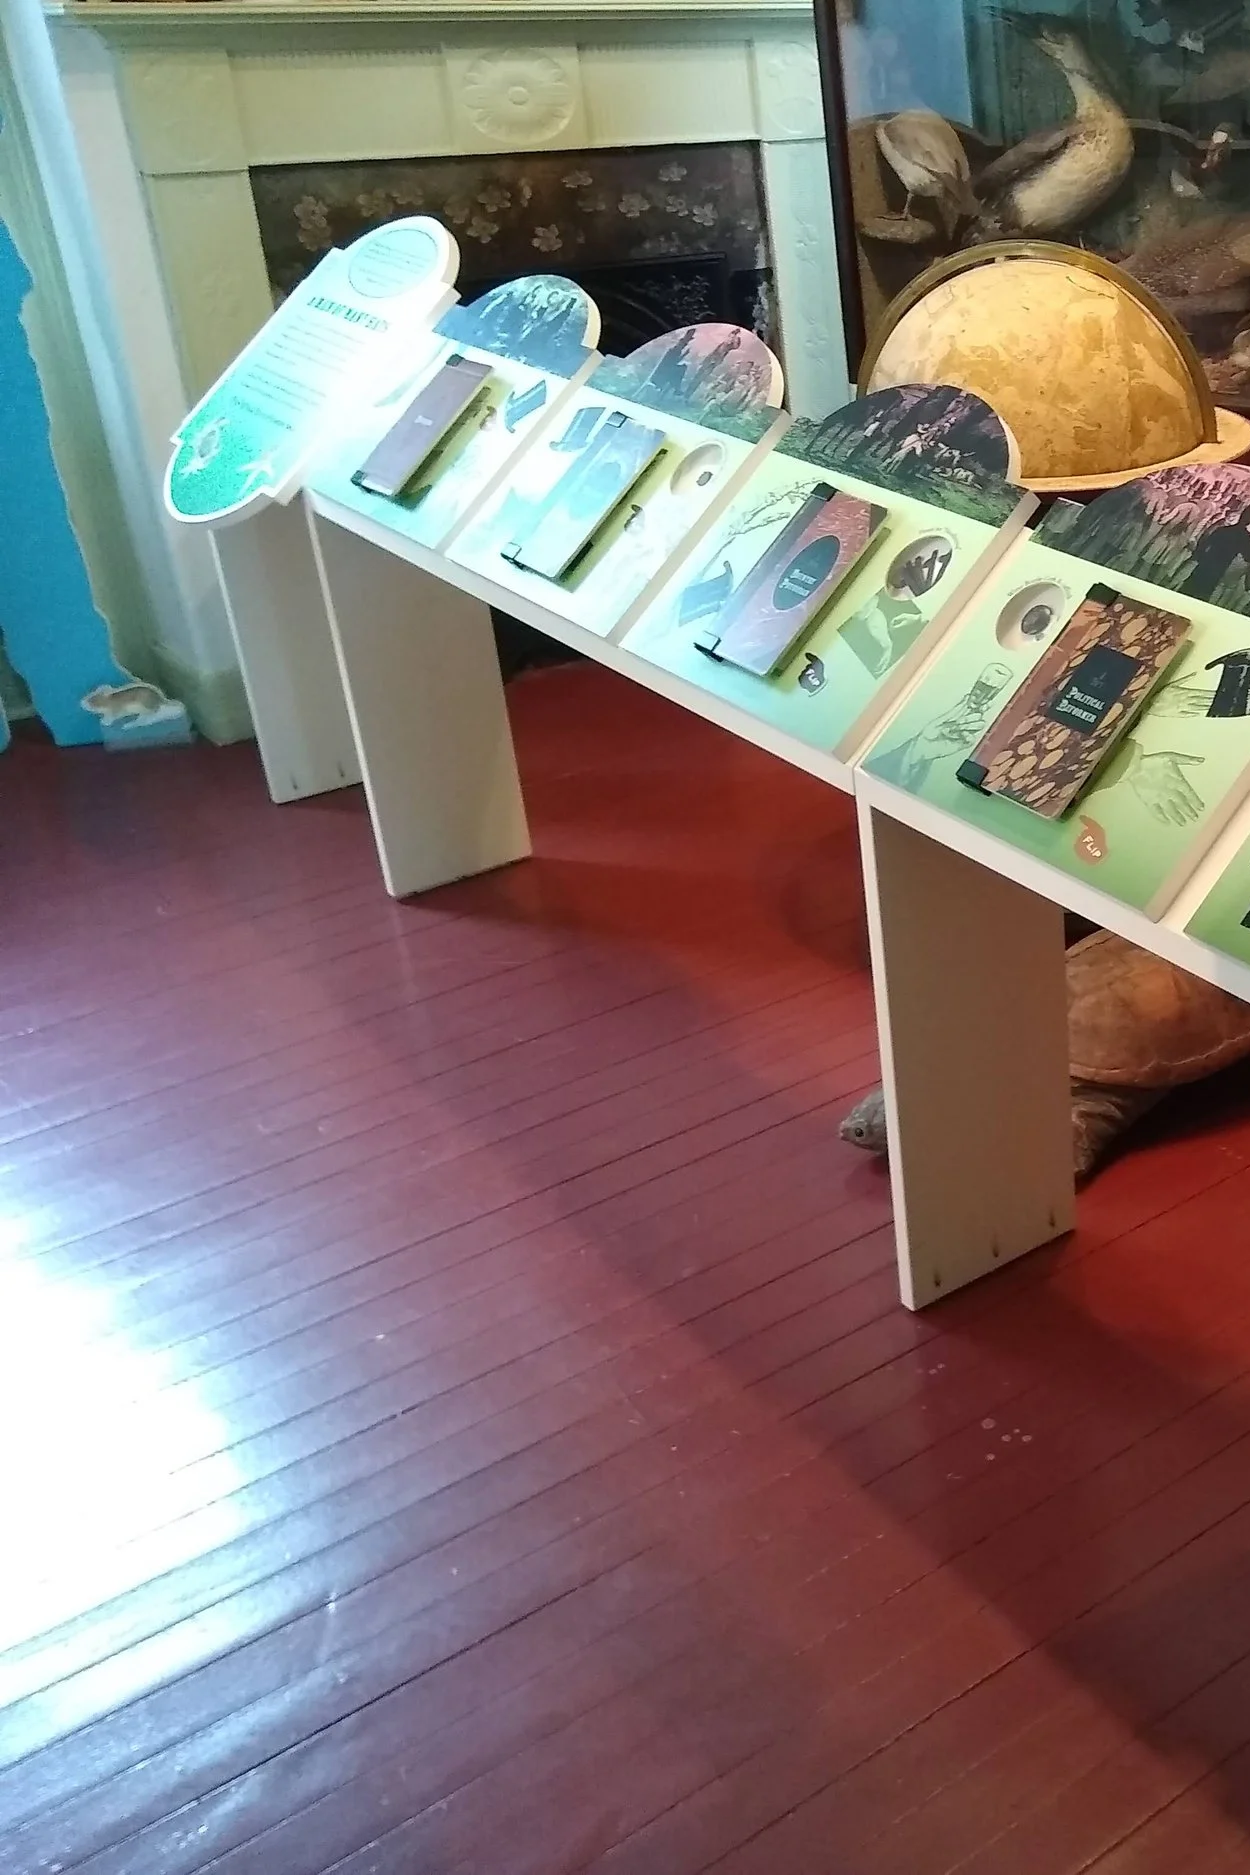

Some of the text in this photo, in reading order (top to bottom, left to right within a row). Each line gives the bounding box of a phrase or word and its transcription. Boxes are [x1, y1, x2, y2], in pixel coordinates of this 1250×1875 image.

[1066, 686, 1106, 711] POLITICAL
[1056, 699, 1097, 723] REFORMER
[1082, 835, 1102, 857] FLIP
